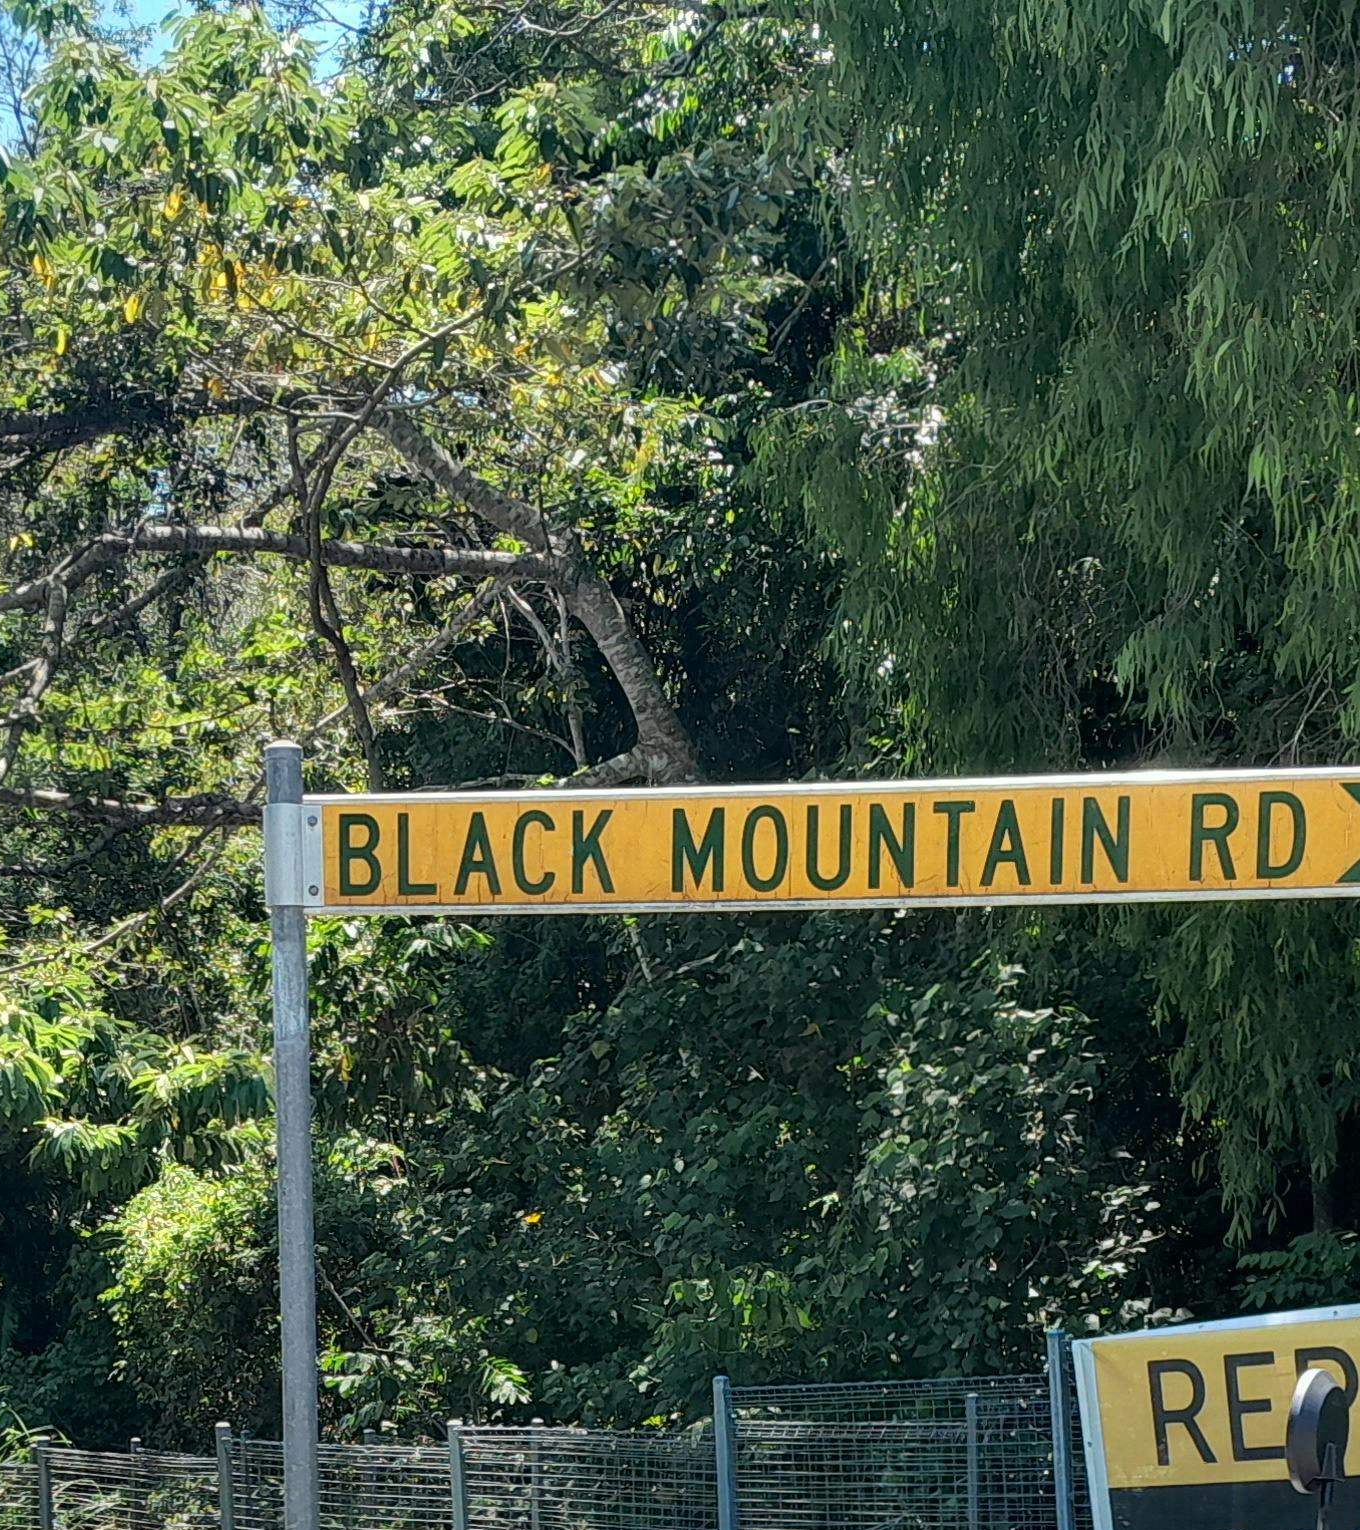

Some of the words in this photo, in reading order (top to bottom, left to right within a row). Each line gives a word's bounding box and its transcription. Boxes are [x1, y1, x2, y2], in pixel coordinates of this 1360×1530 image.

[337, 807, 616, 898] BLACK
[670, 794, 1135, 892] MOUNTAIN
[1188, 789, 1307, 882] RD
